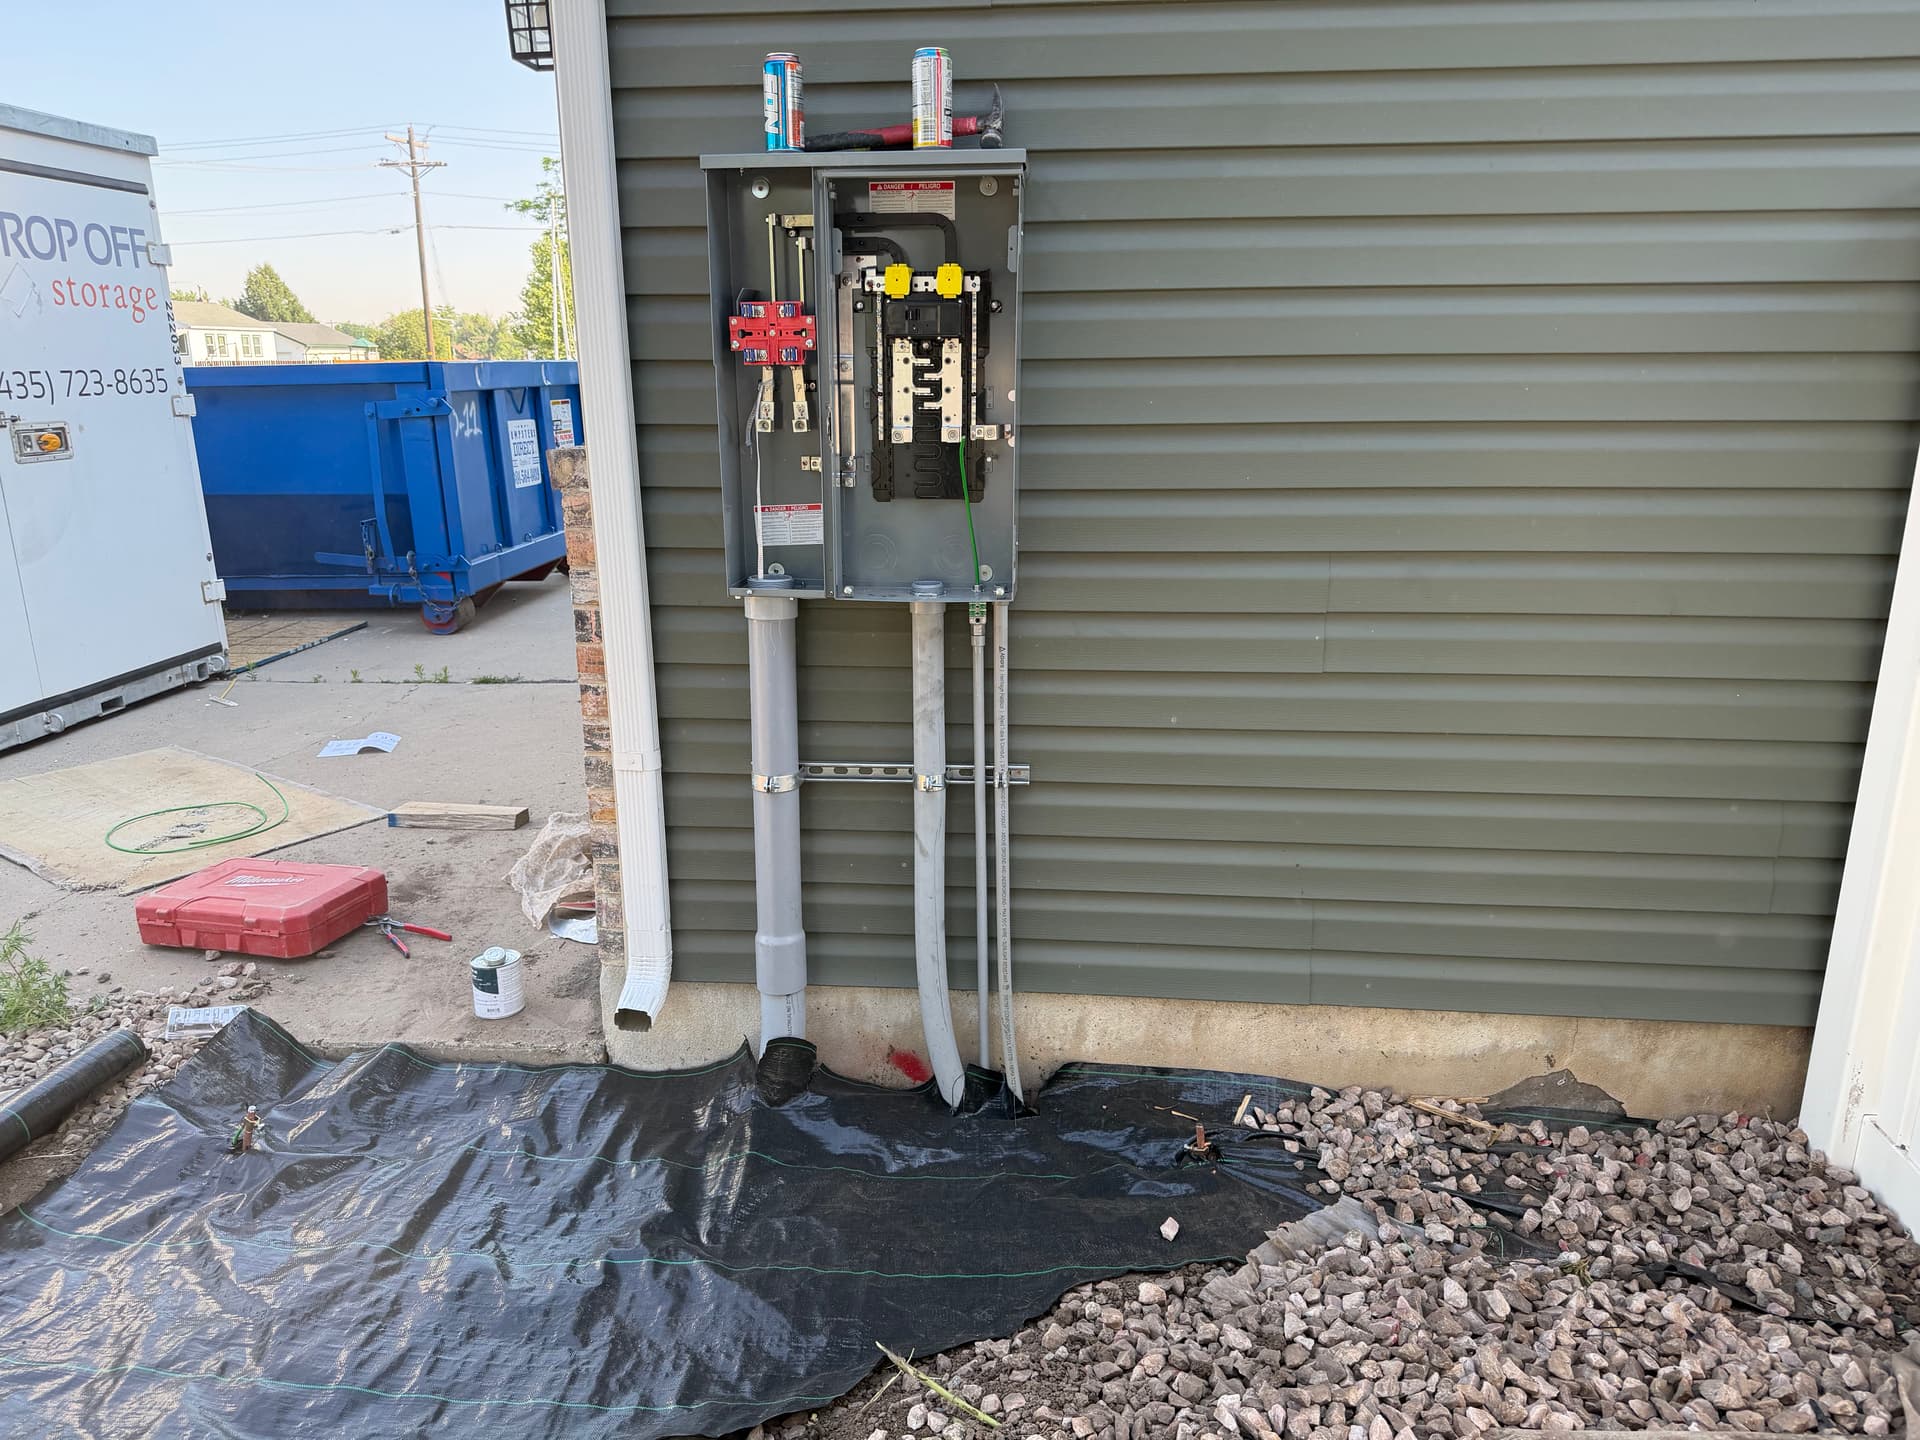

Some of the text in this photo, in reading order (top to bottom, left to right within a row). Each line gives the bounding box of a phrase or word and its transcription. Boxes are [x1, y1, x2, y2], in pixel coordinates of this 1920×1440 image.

[763, 73, 779, 134] NOS
[52, 276, 158, 323] storage
[165, 300, 182, 365] 222033
[60, 368, 168, 397] 723-8635
